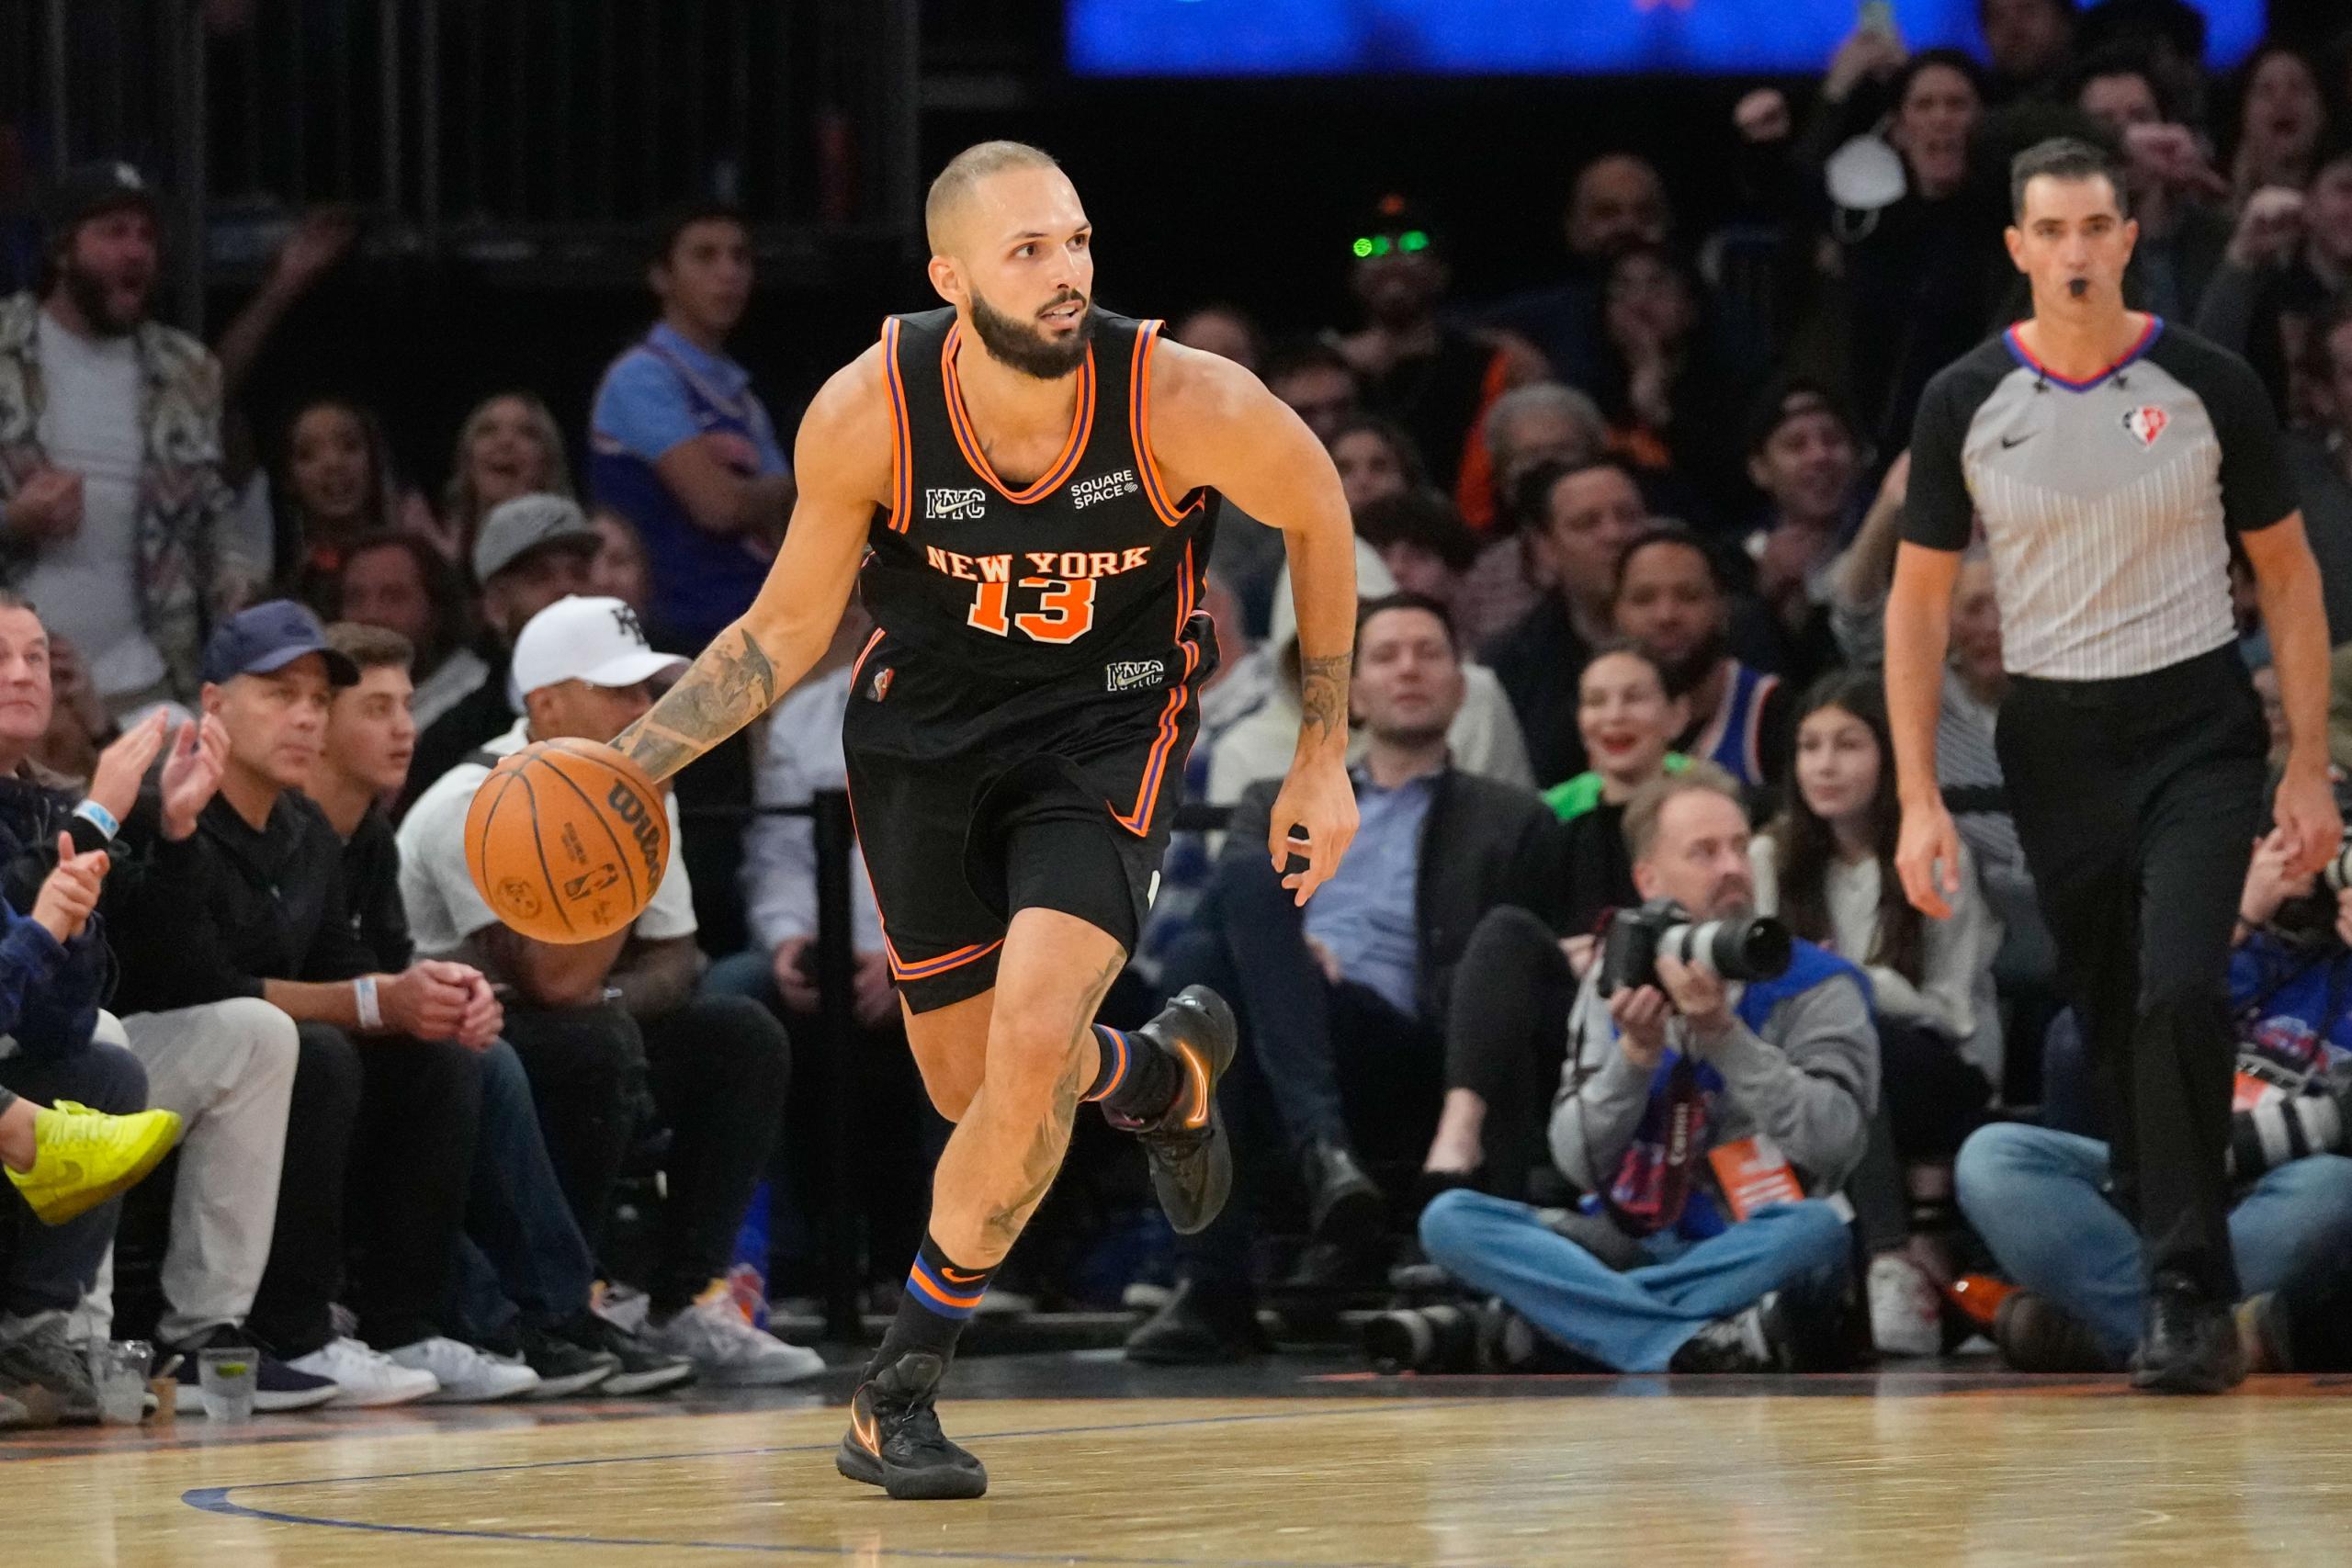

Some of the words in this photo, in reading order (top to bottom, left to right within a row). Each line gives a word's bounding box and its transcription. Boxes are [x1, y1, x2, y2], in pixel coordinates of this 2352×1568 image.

[1070, 469, 1134, 497] SQUARE
[1074, 484, 1124, 510] SPACE
[925, 488, 986, 520] NYC
[926, 544, 1013, 583] NEW
[1024, 546, 1151, 579] YORK
[967, 576, 1097, 645] 13
[1106, 660, 1165, 692] NYC
